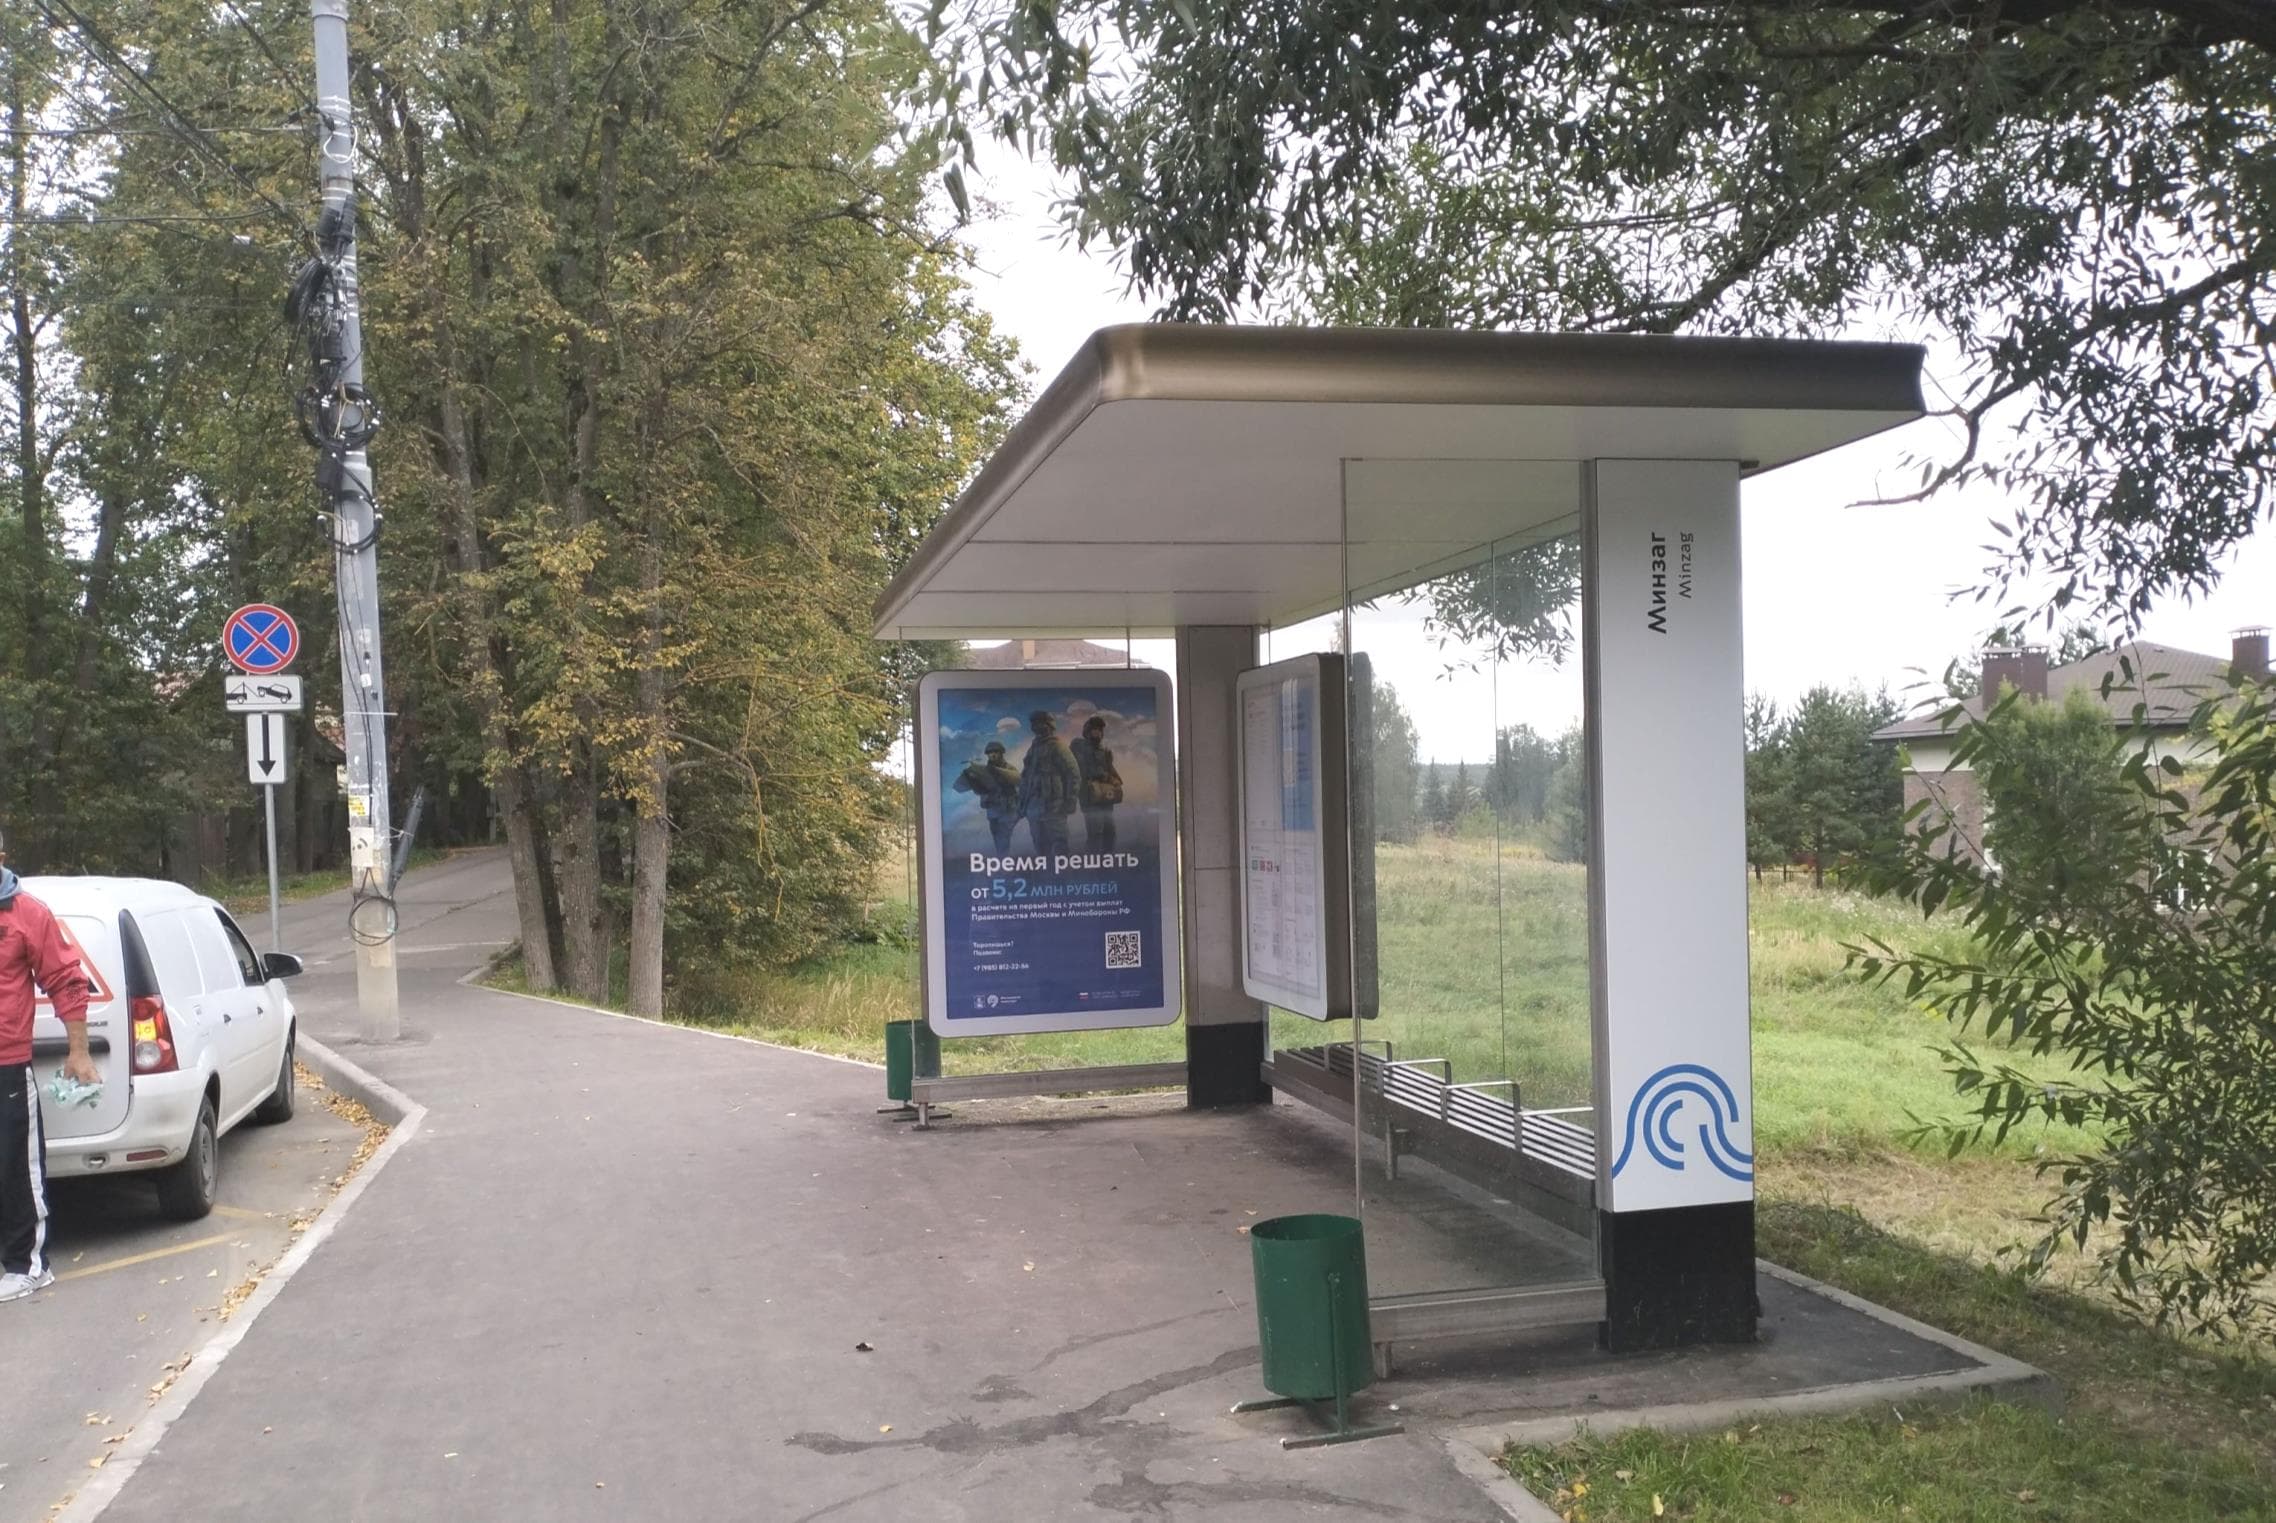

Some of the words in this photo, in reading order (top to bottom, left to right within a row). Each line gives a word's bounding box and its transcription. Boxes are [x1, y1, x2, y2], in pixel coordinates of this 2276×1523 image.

[1679, 532, 1694, 598] Minzag
[1647, 531, 1667, 634] Минзаг
[969, 853, 1047, 877] Время
[1054, 852, 1139, 874] решать
[971, 887, 989, 899] от
[992, 878, 1027, 901] 5,2
[1030, 885, 1063, 897] МЛН
[1066, 881, 1118, 895] РУБЛЕЙ
[971, 912, 1029, 921] Правительства
[1029, 911, 1060, 920] Москвы
[1068, 908, 1118, 918] Минобороны
[1119, 907, 1131, 915] РФ
[1019, 902, 1048, 911] первый
